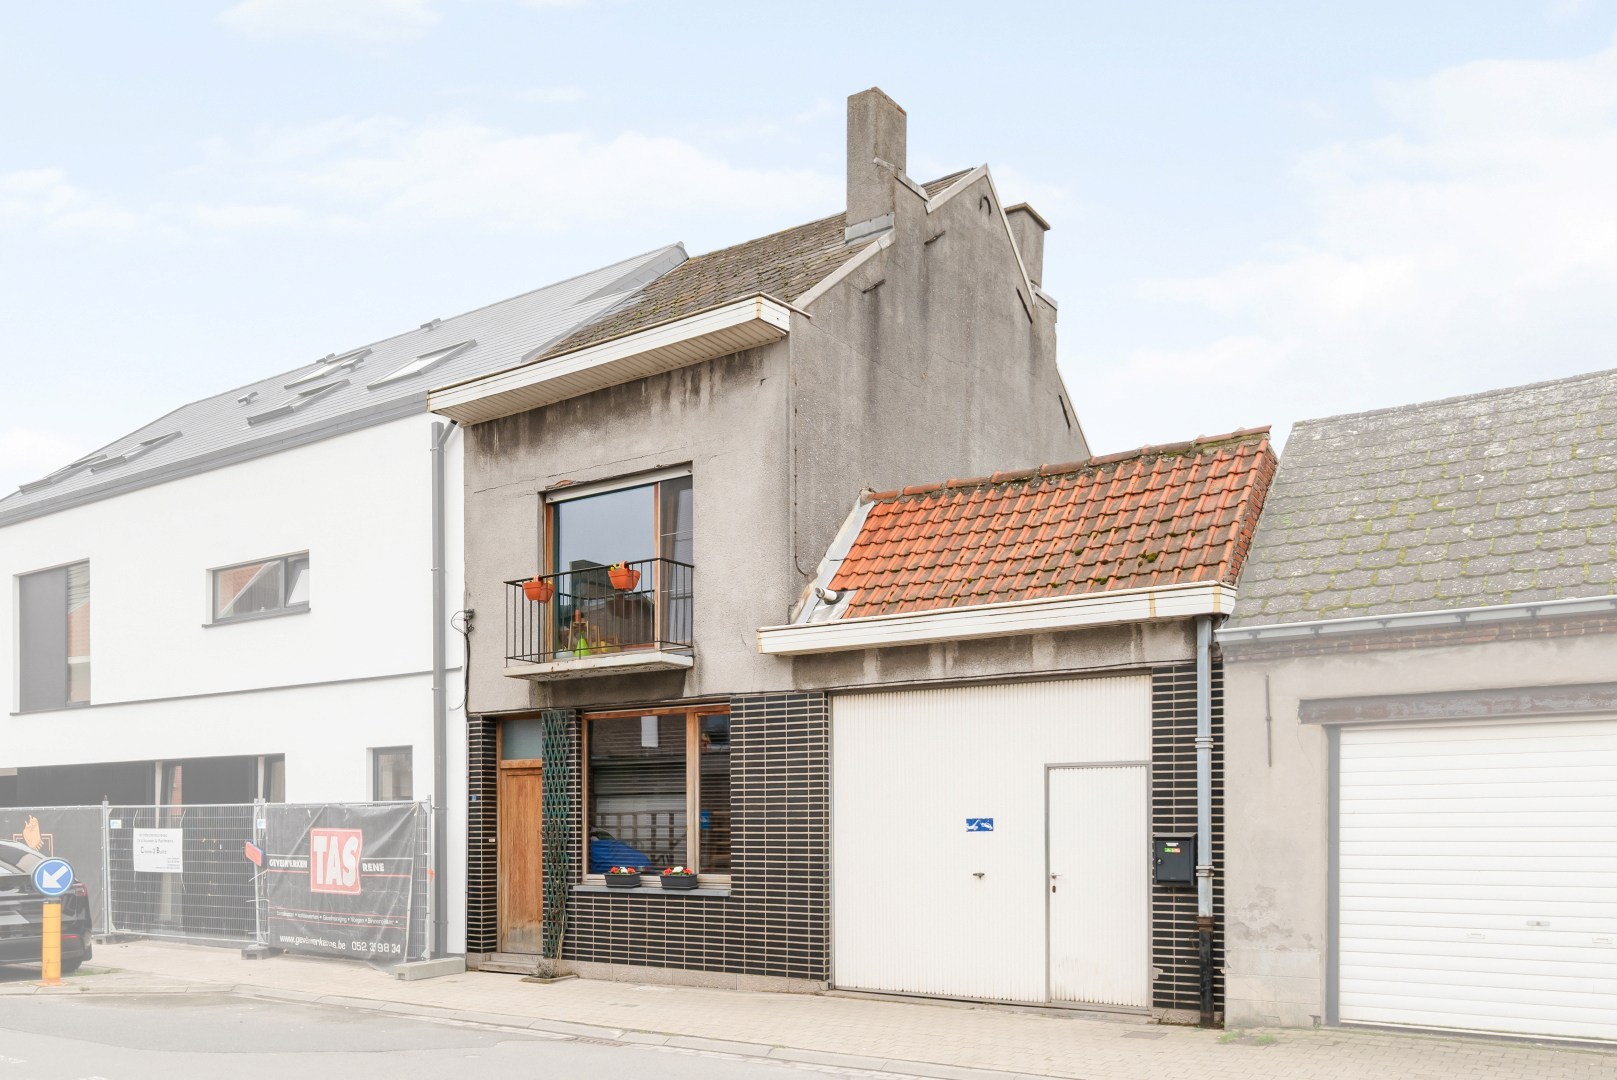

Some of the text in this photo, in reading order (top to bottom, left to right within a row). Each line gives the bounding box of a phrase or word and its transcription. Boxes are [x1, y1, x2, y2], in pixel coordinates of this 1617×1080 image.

[313, 835, 359, 887] TAS
[362, 863, 385, 872] RENE
[391, 943, 401, 954] 34
